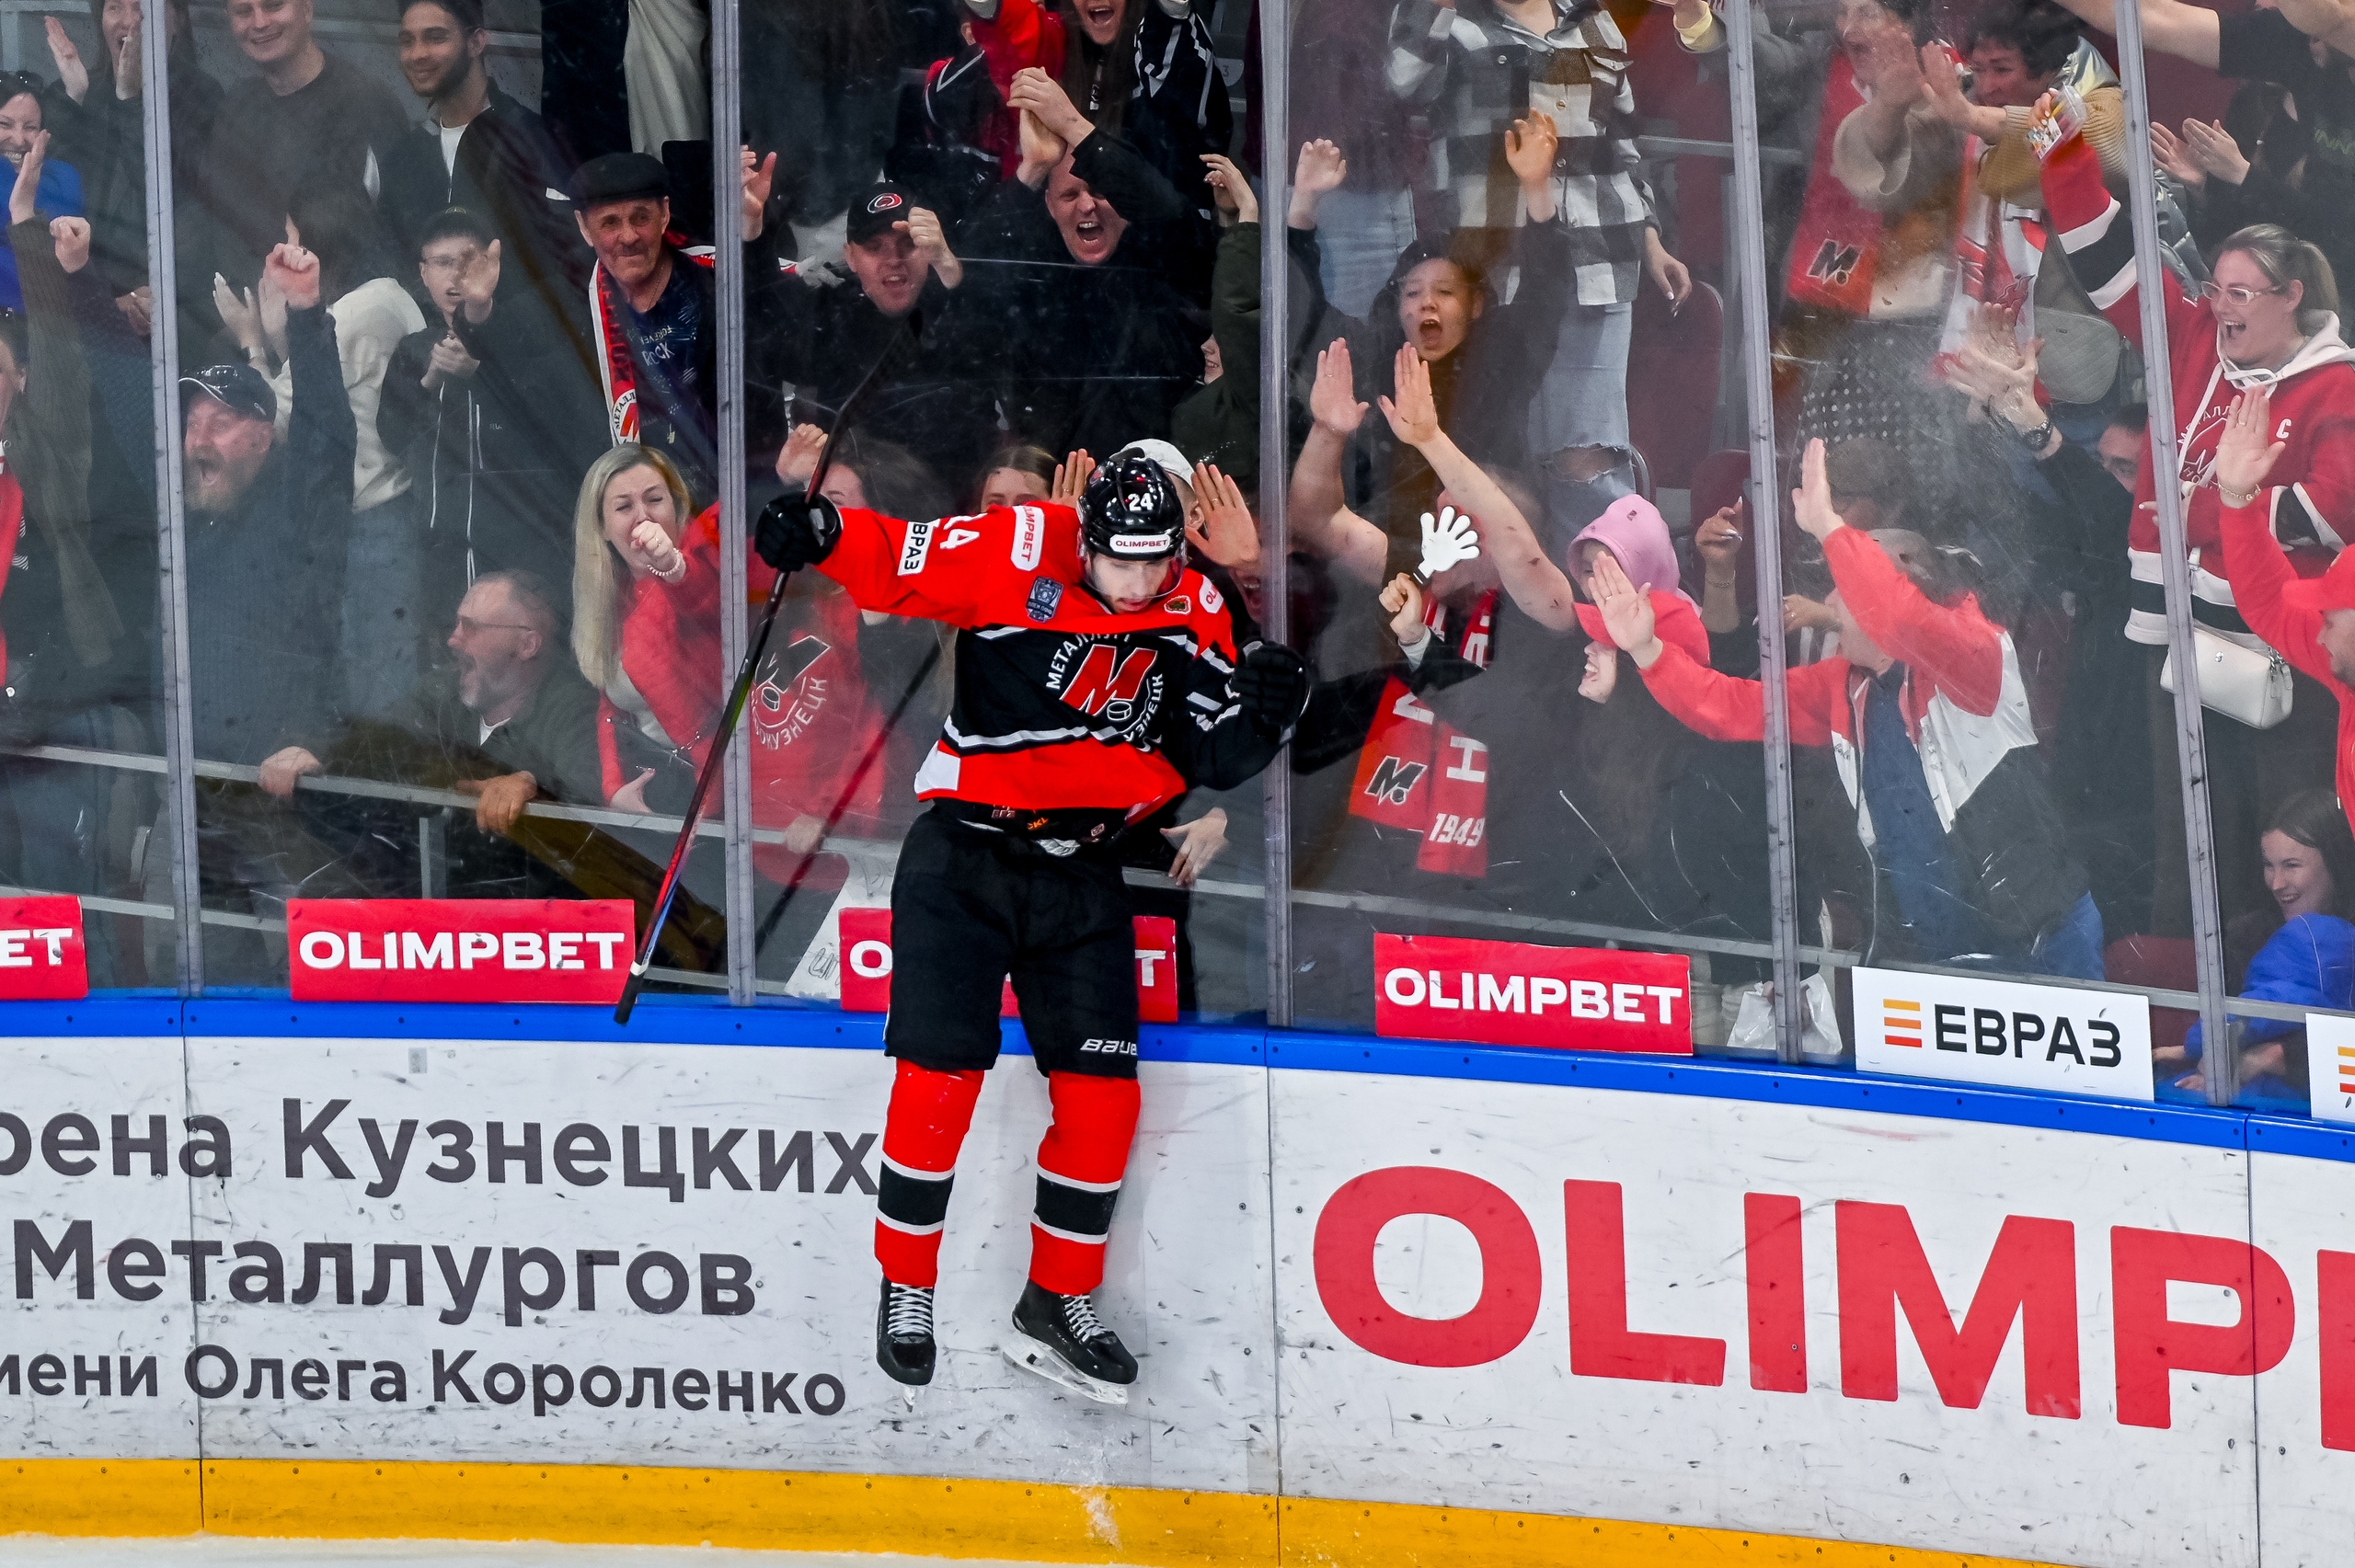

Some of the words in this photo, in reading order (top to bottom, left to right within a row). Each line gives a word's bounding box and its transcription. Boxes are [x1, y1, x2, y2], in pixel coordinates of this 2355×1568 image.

[1128, 492, 1155, 512] 24
[903, 522, 929, 570] ВРАЗ
[1115, 539, 1168, 548] OLIMPBET
[1429, 812, 1486, 847] 1949
[0, 928, 74, 967] ET
[299, 931, 626, 970] OLIMPBET
[1384, 967, 1683, 1025] OLIMPBET
[1934, 1003, 2122, 1068] ЕВРАЗ
[282, 1097, 879, 1203] Кузнецких
[14, 1219, 756, 1327] Металлургов
[1313, 1164, 2355, 1451] OLIMP
[184, 1344, 408, 1402] Олега
[431, 1348, 846, 1417] Короленко
